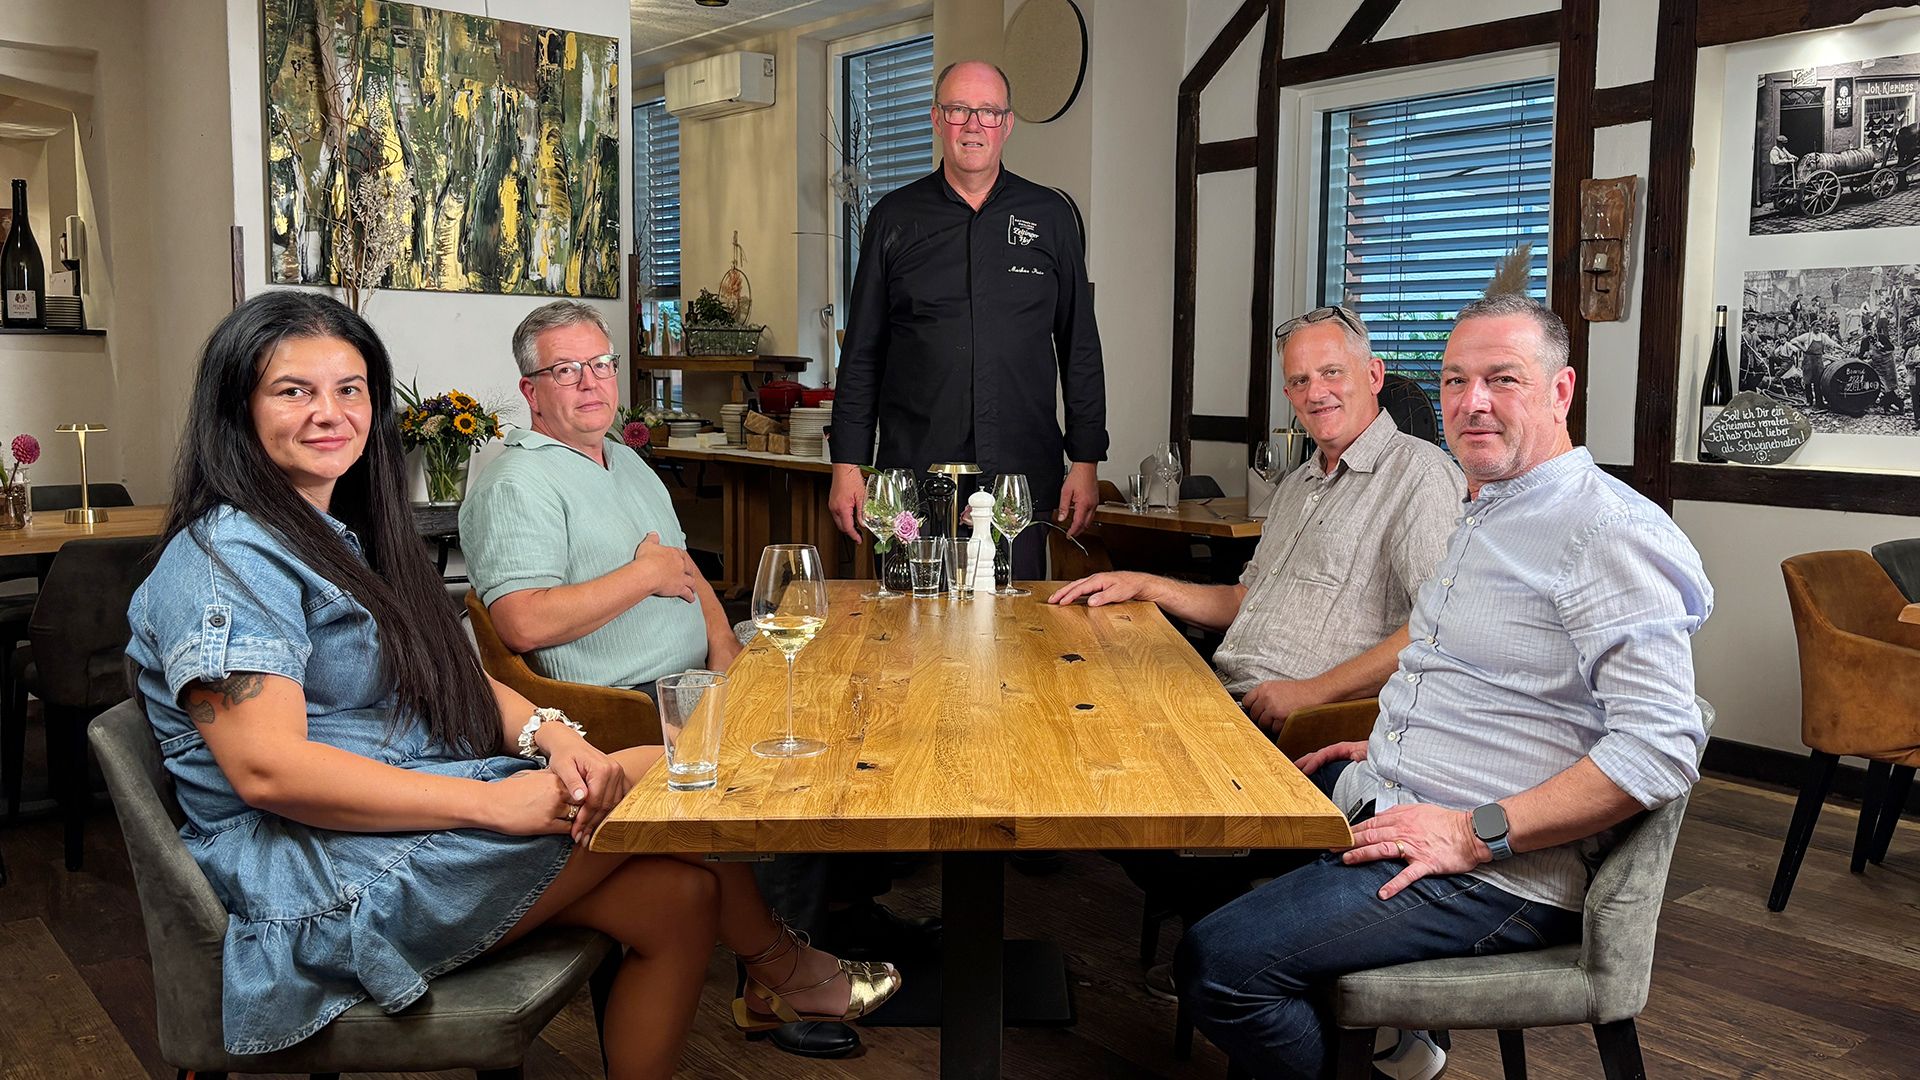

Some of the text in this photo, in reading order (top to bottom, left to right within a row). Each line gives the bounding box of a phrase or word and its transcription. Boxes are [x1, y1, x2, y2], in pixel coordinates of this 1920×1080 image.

[1720, 409, 1740, 423] Soll
[1755, 407, 1769, 418] Dir
[1771, 405, 1785, 417] ein
[1713, 420, 1756, 432] Geheimnis
[1704, 431, 1725, 442] Ich
[1743, 428, 1764, 440] Dich
[1765, 427, 1790, 438] lieber
[1721, 442, 1735, 454] als
